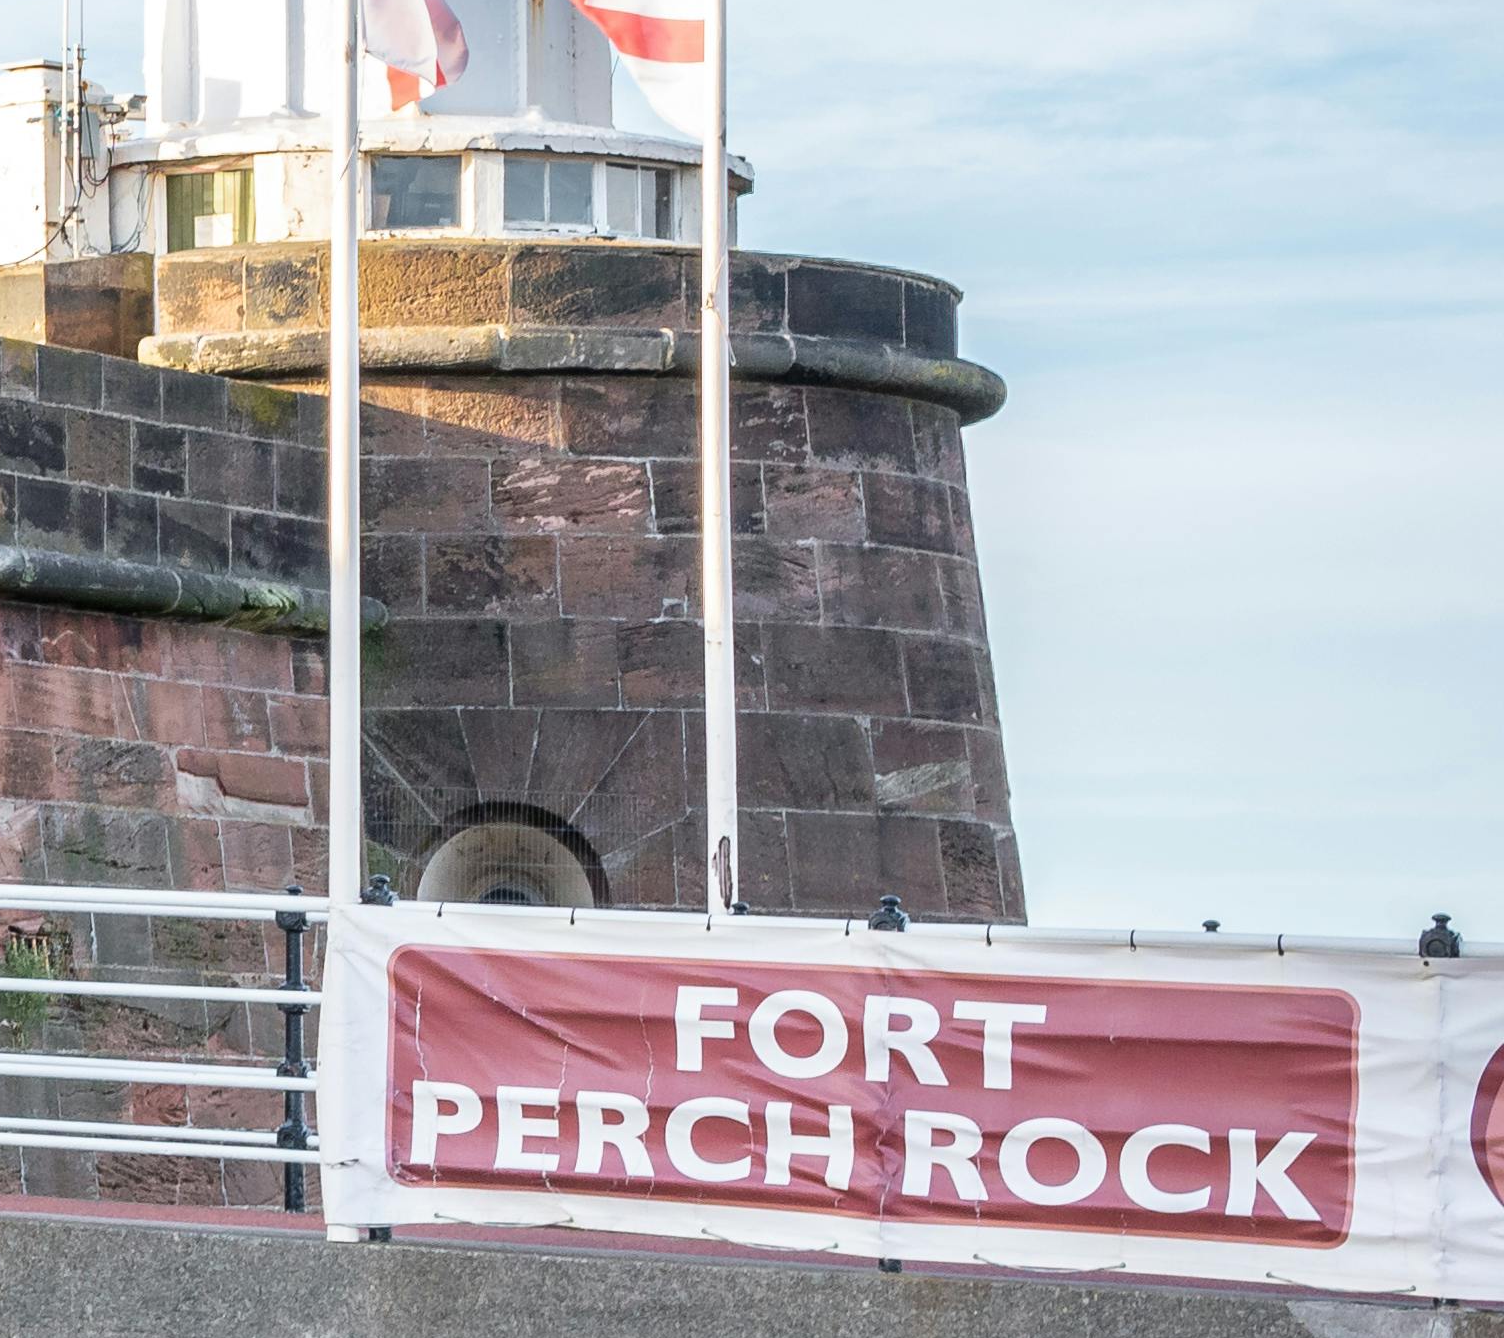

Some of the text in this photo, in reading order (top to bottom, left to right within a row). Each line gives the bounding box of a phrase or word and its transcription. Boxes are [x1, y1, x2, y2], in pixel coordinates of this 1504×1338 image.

[674, 984, 1048, 1092] FORT
[408, 1079, 1322, 1223] PERCH ROCK
